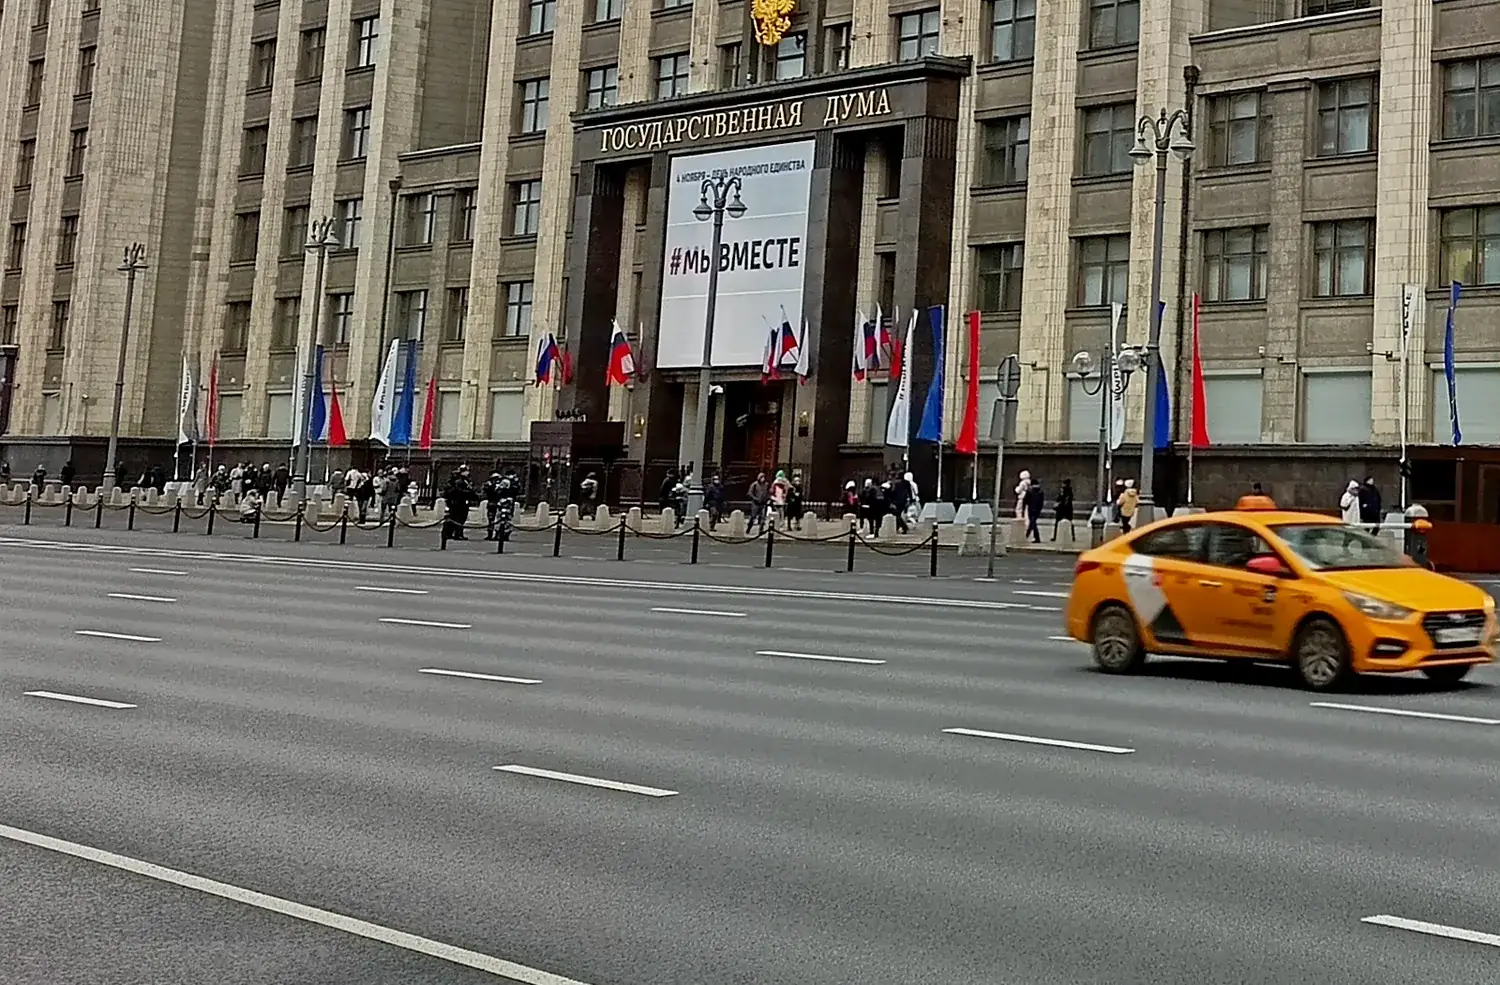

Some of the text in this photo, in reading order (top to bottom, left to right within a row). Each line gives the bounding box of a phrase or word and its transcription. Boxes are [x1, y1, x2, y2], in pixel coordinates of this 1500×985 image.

[600, 88, 892, 152] ГОСУДАРСТВЕННАЯ ДУМА
[729, 163, 769, 177] НАРОДНОГО
[769, 160, 806, 174] ЕДИНСТВА
